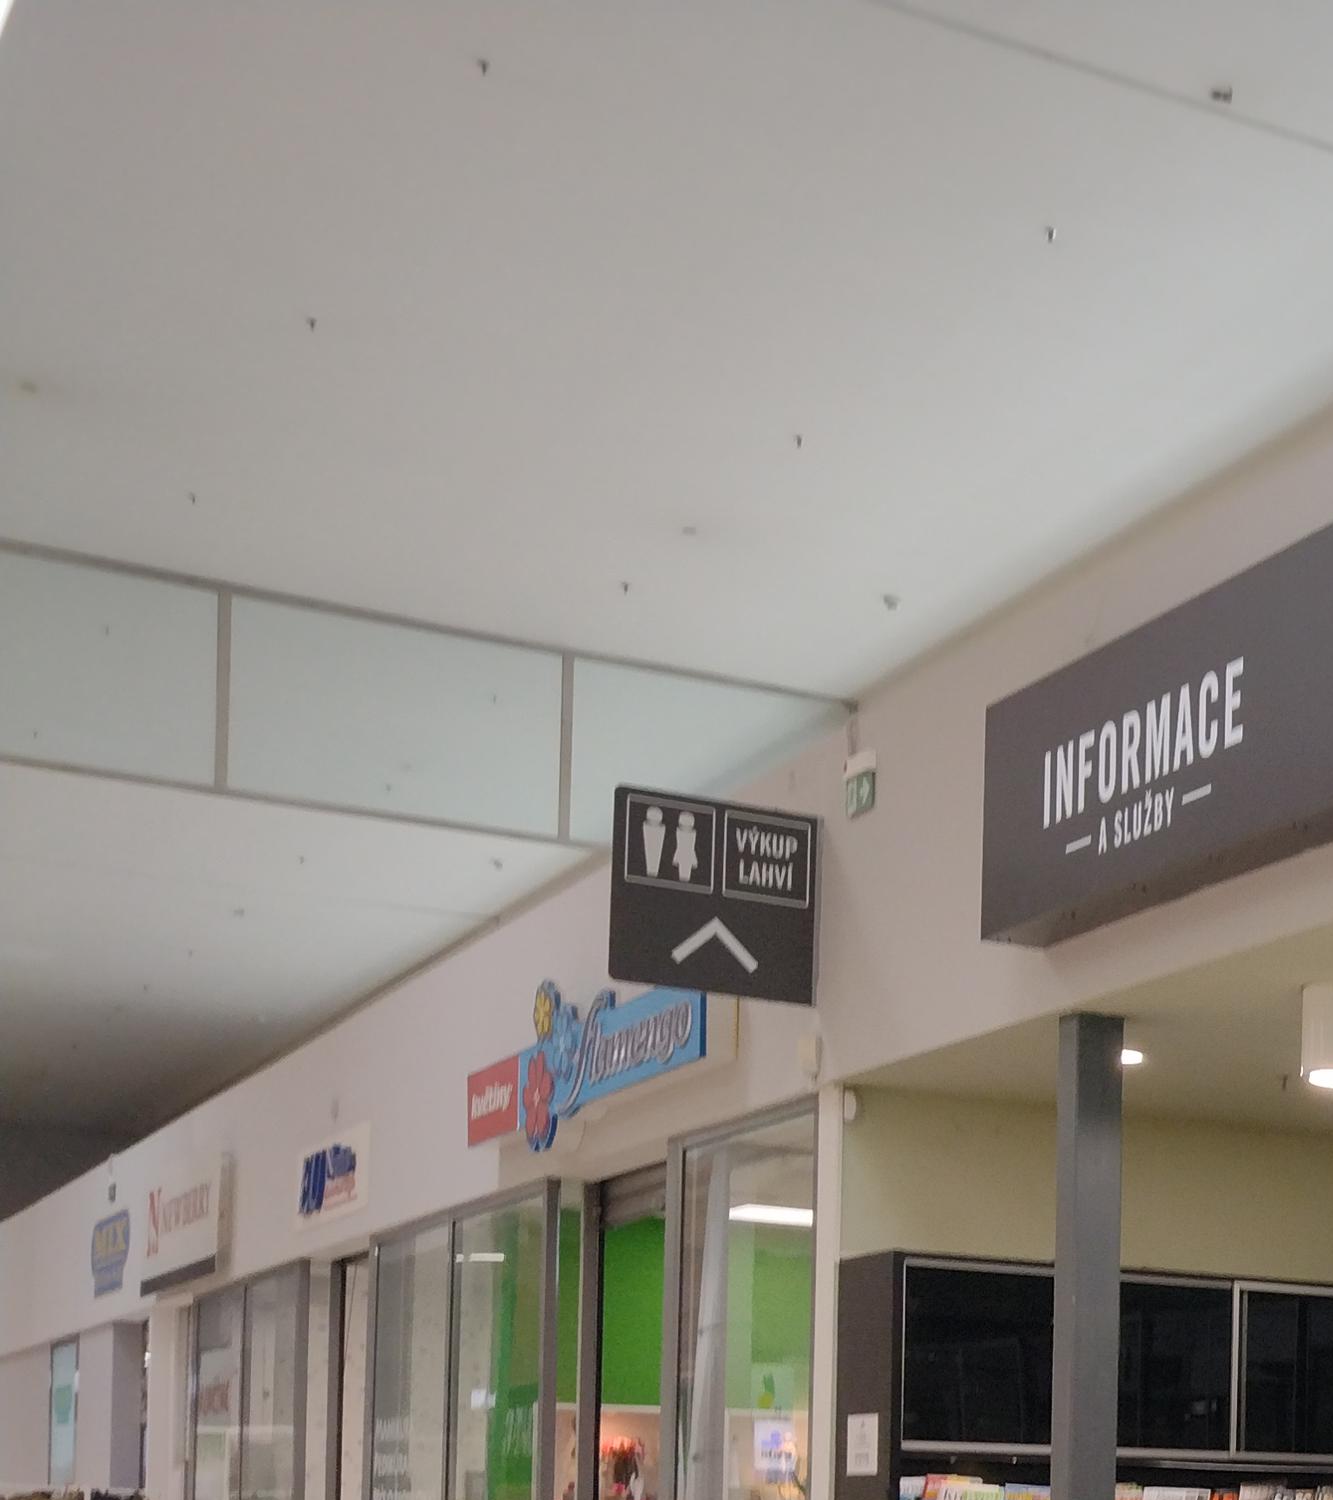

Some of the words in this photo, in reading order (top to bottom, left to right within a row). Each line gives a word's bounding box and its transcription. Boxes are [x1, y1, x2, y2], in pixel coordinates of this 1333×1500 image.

[1042, 656, 1244, 829] INFORMACE
[736, 826, 798, 860] VÝKUP
[1098, 824, 1108, 855] A
[1113, 787, 1175, 849] SLUŽBY
[739, 857, 793, 891] LAHVÍ
